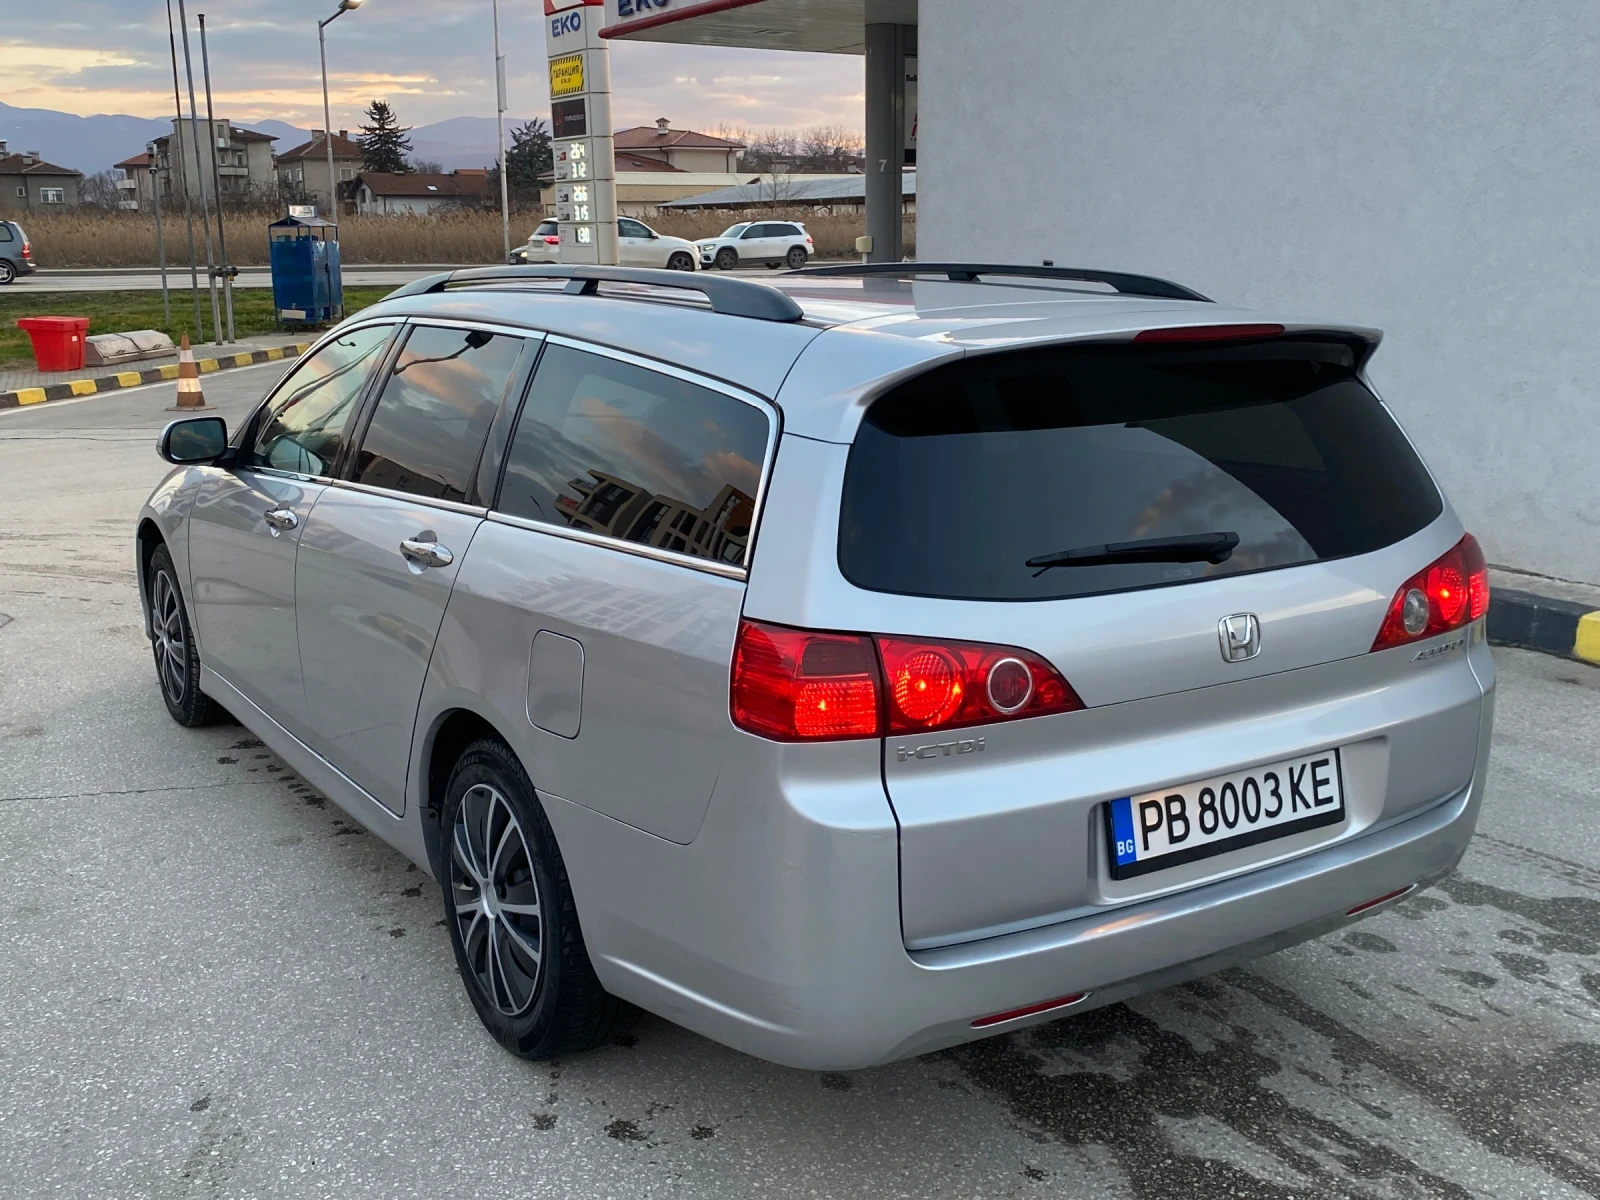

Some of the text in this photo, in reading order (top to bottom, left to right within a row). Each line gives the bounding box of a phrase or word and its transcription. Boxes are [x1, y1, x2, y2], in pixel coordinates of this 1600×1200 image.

[551, 11, 581, 38] EKO
[878, 159, 888, 172] 7
[897, 737, 986, 762] i-CTDi
[1139, 758, 1334, 851] PB 8003 KE
[1117, 838, 1134, 856] BG
